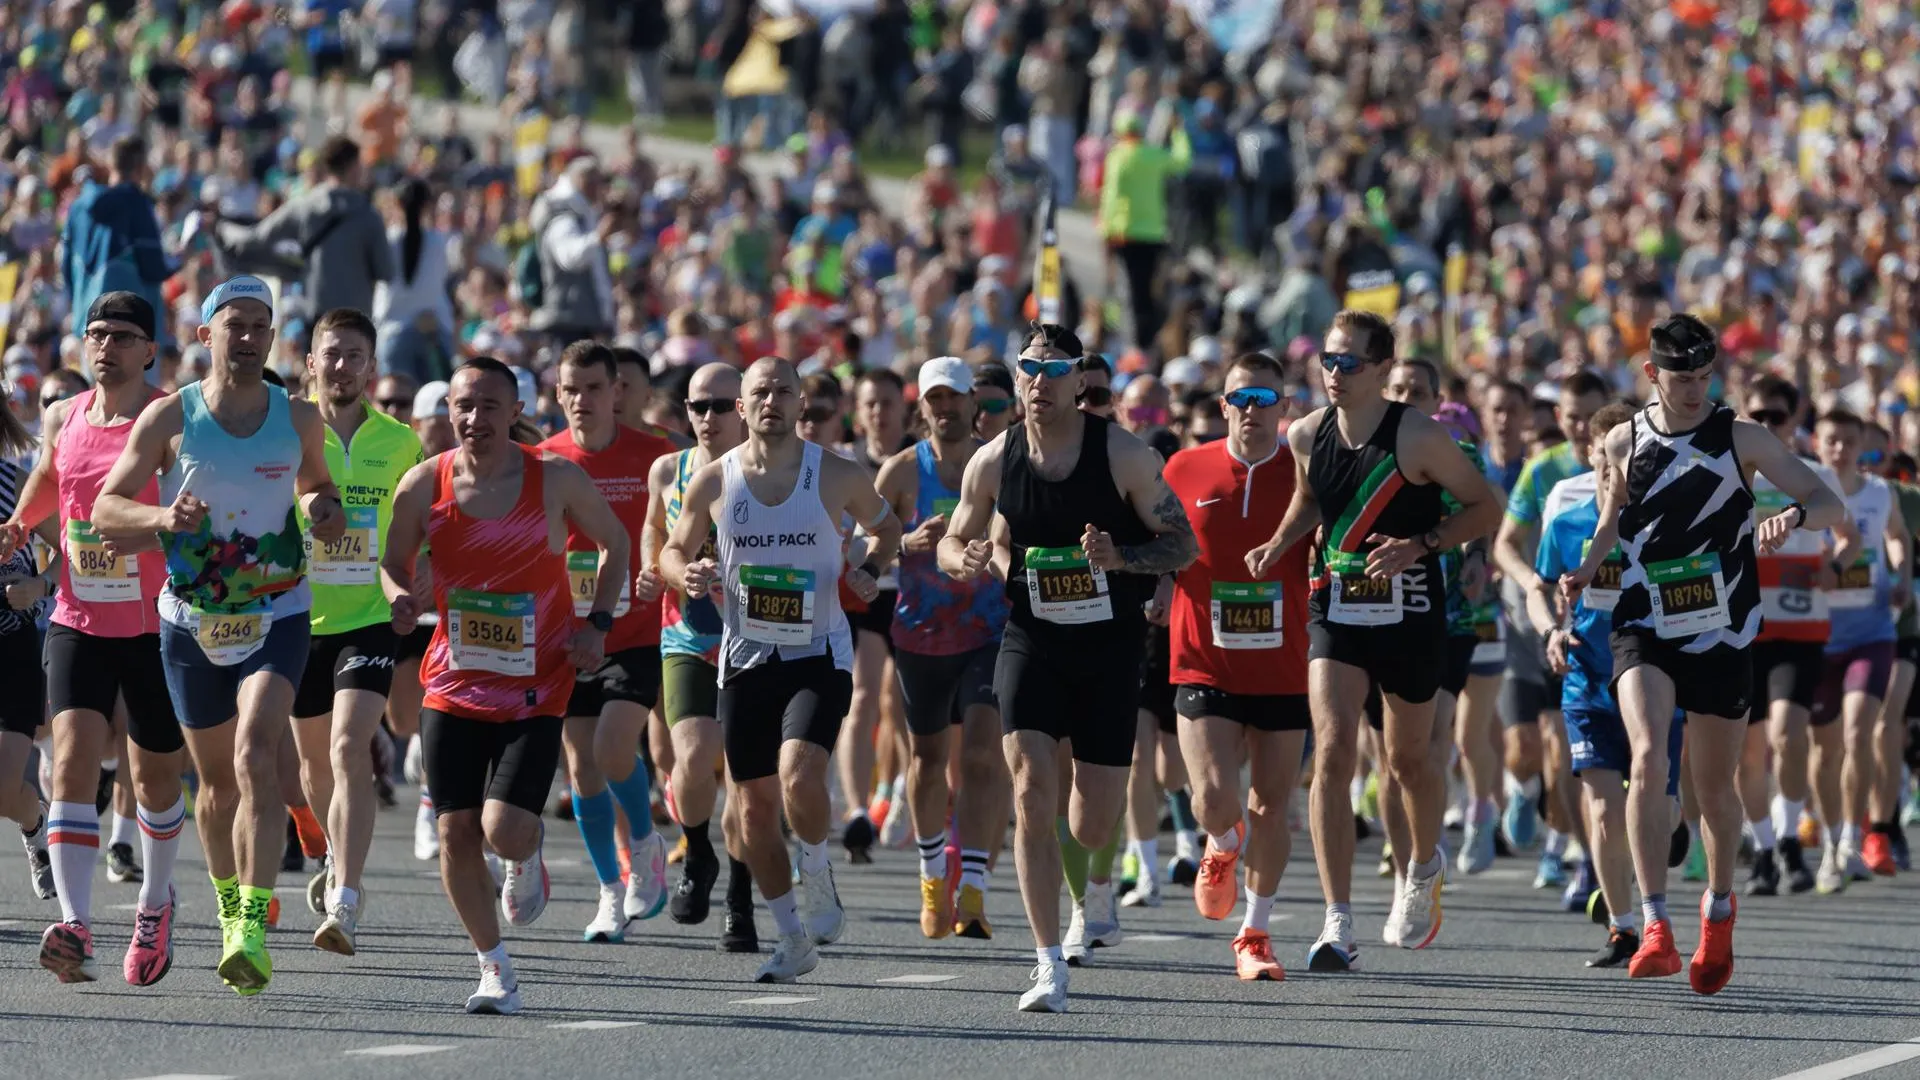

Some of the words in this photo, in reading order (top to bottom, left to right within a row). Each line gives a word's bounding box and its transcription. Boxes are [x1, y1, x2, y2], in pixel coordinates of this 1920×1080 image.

[346, 496, 380, 506] CLUB
[733, 534, 774, 548] WOLF
[778, 532, 817, 547] PACK
[79, 550, 117, 571] 8849
[1043, 573, 1093, 596] 11933
[1345, 578, 1389, 597] 18799
[1402, 563, 1432, 613] GR
[753, 594, 800, 617] 13873
[1665, 583, 1713, 608] 18796
[1225, 608, 1271, 627] 14418
[210, 621, 252, 641] 4346
[468, 620, 517, 645] 3584
